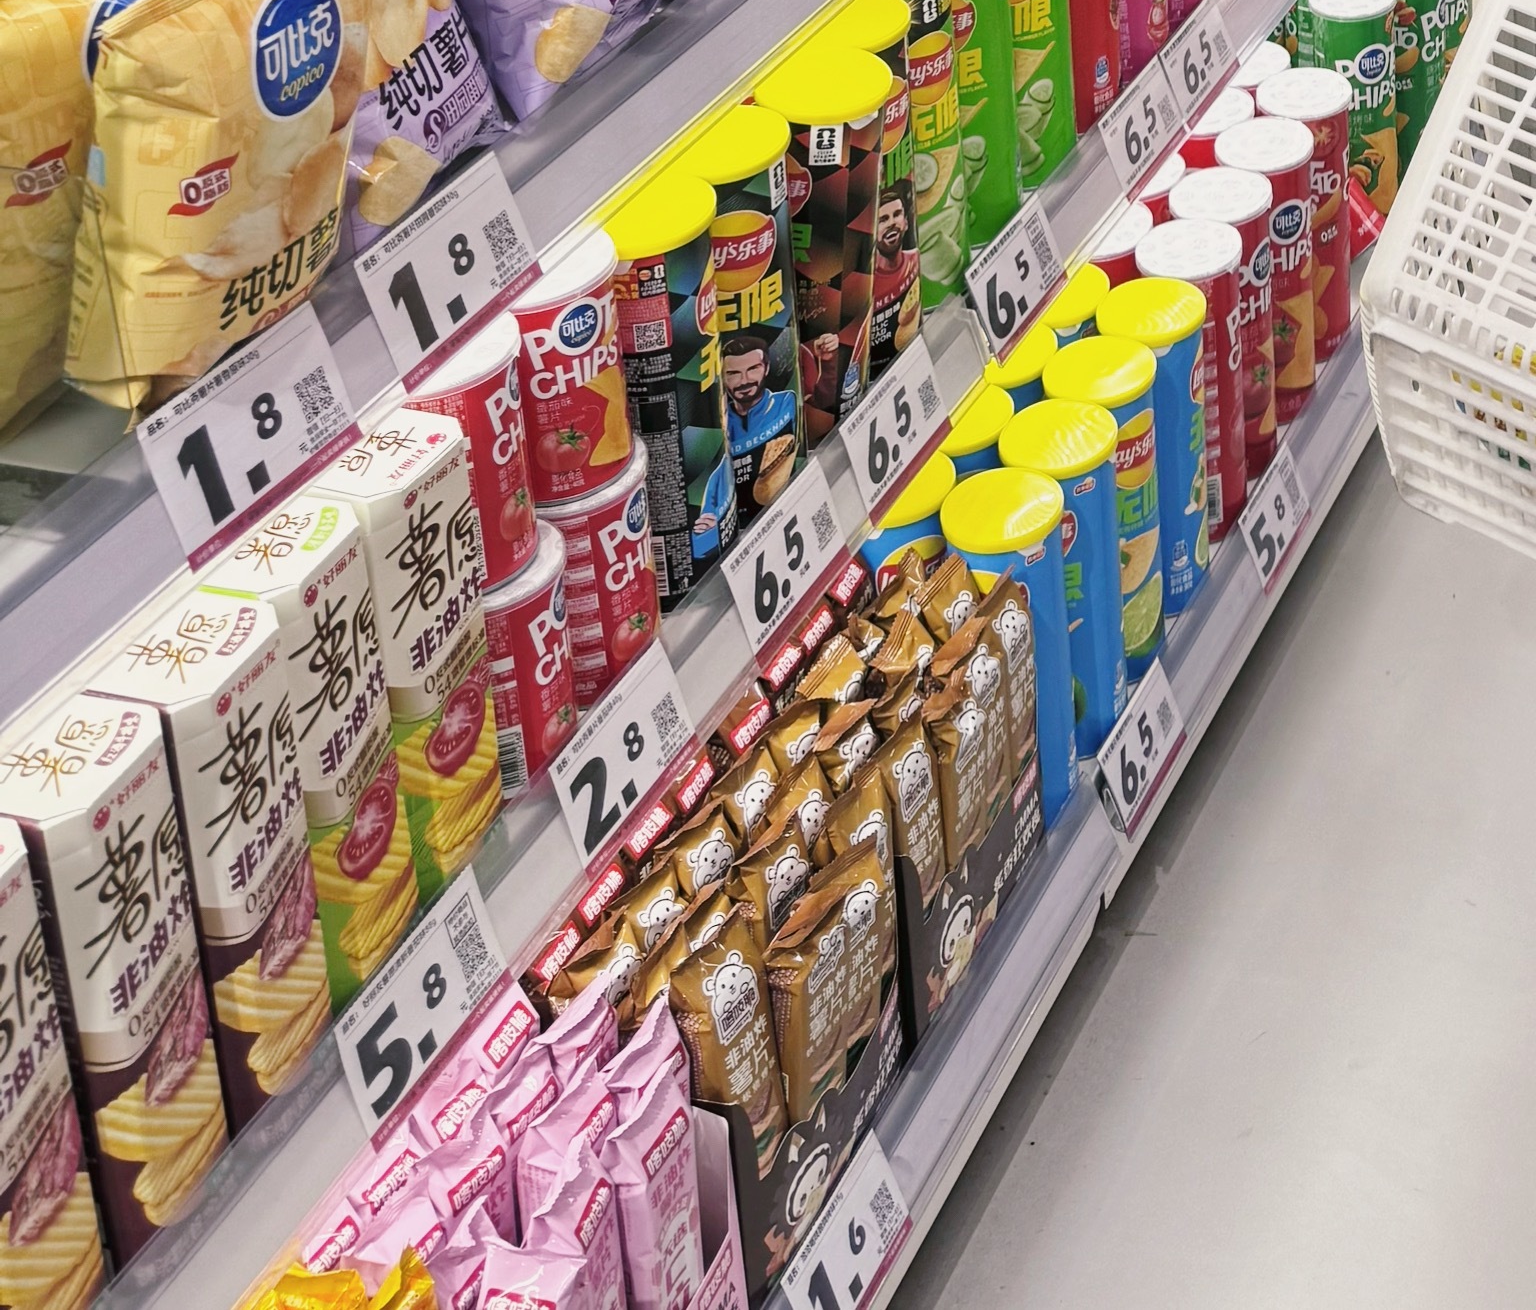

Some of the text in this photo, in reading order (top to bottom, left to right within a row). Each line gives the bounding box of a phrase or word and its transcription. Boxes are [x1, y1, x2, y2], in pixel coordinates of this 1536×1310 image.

[258, 0, 336, 82] 可比克
[1183, 28, 1214, 93] 6.5
[1124, 97, 1158, 165] 6.5
[388, 233, 475, 353] 1.8
[985, 250, 1031, 345] 6.5
[529, 340, 619, 401] CHIPS
[177, 392, 282, 527] 1.8
[744, 411, 791, 450] BECKHAM
[867, 386, 912, 485] 6.5
[754, 514, 805, 625] 6.5
[569, 721, 645, 857] 2.8
[1118, 715, 1156, 807] 6.5
[356, 962, 447, 1120] 5.8
